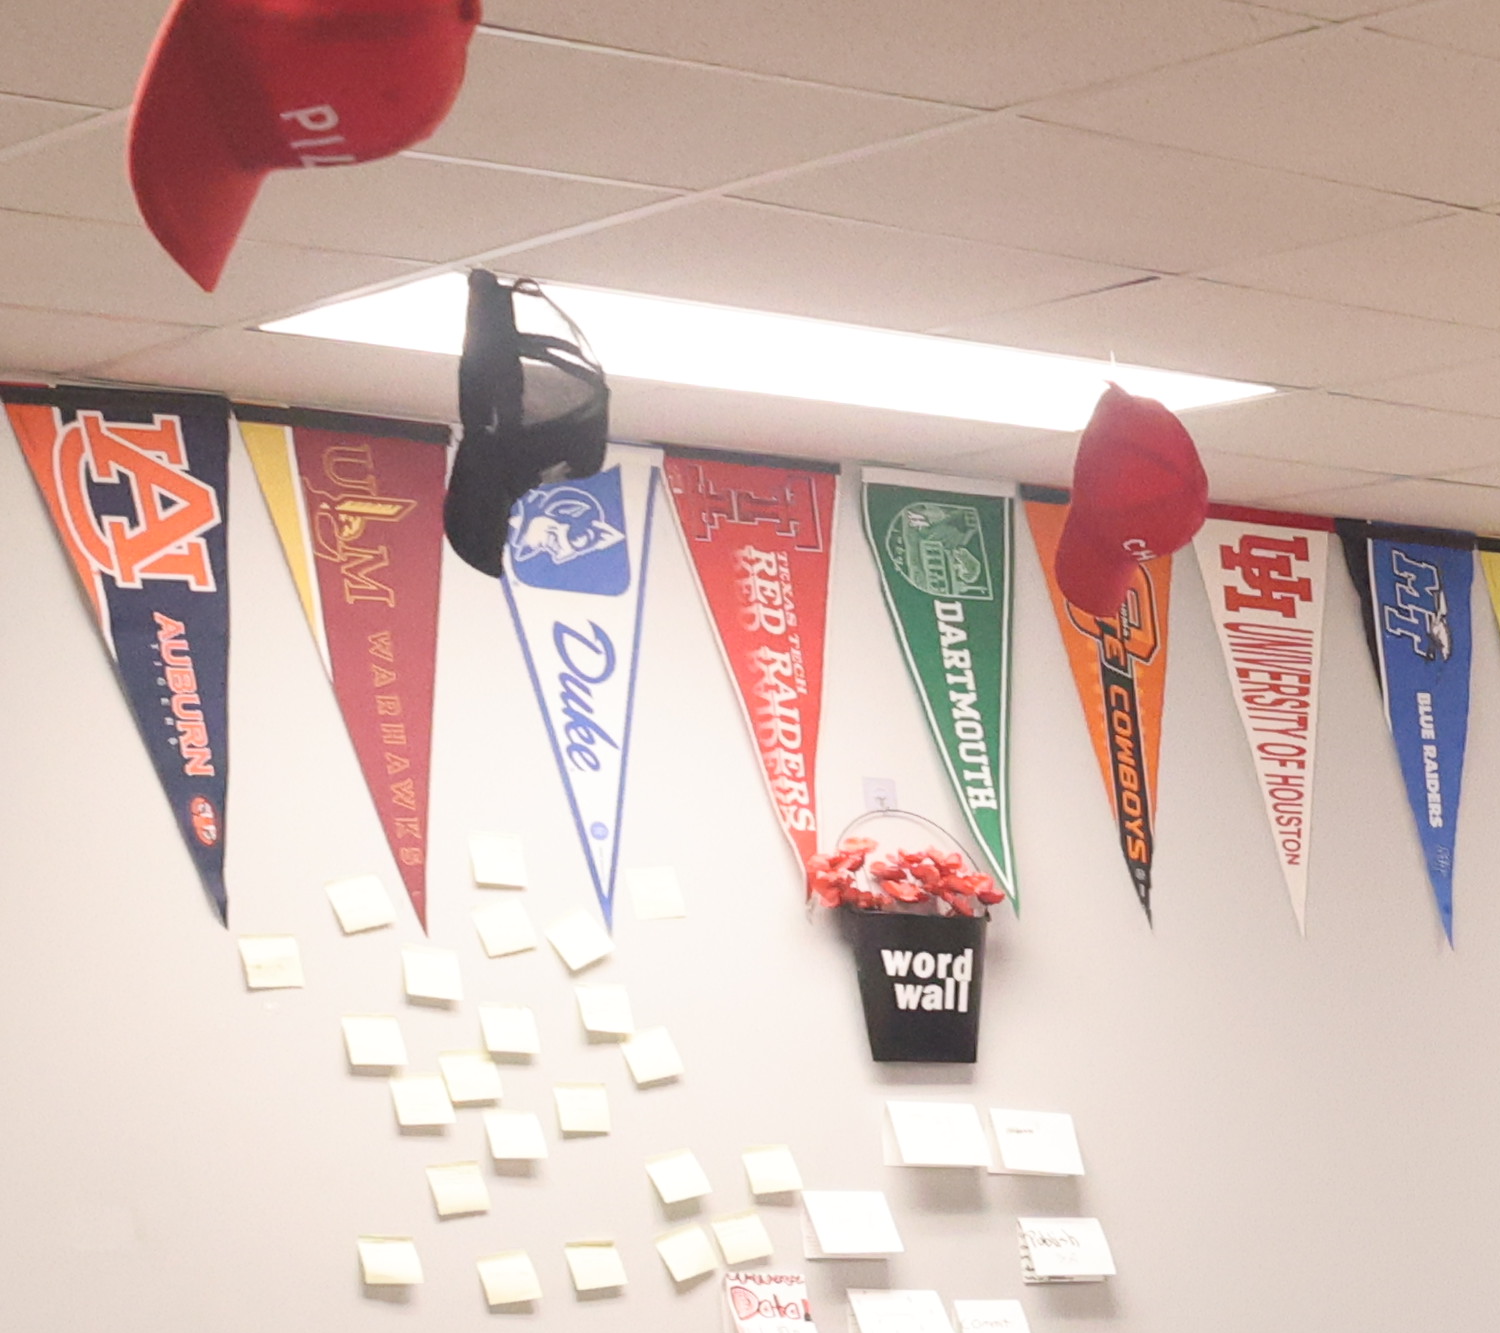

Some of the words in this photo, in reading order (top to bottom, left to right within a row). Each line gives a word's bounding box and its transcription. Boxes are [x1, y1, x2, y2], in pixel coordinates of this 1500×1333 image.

[743, 545, 788, 636] RED
[776, 552, 797, 627] TEXAS
[788, 633, 808, 696] TECH
[153, 611, 215, 777] AUBURN
[553, 619, 621, 773] Duke
[760, 646, 817, 831] RAIDERS
[933, 600, 998, 811] DARTMOUTH
[1223, 622, 1314, 740] UNIVERSITY
[1416, 692, 1435, 740] BLUE
[368, 631, 422, 867] WARHAWKS
[1109, 684, 1149, 864] COWBOYS
[1257, 742, 1307, 770] OF
[1423, 745, 1443, 829] RAIDERS
[1265, 774, 1305, 866] HOUSTON
[881, 948, 973, 982] word
[894, 978, 969, 1012] wall
